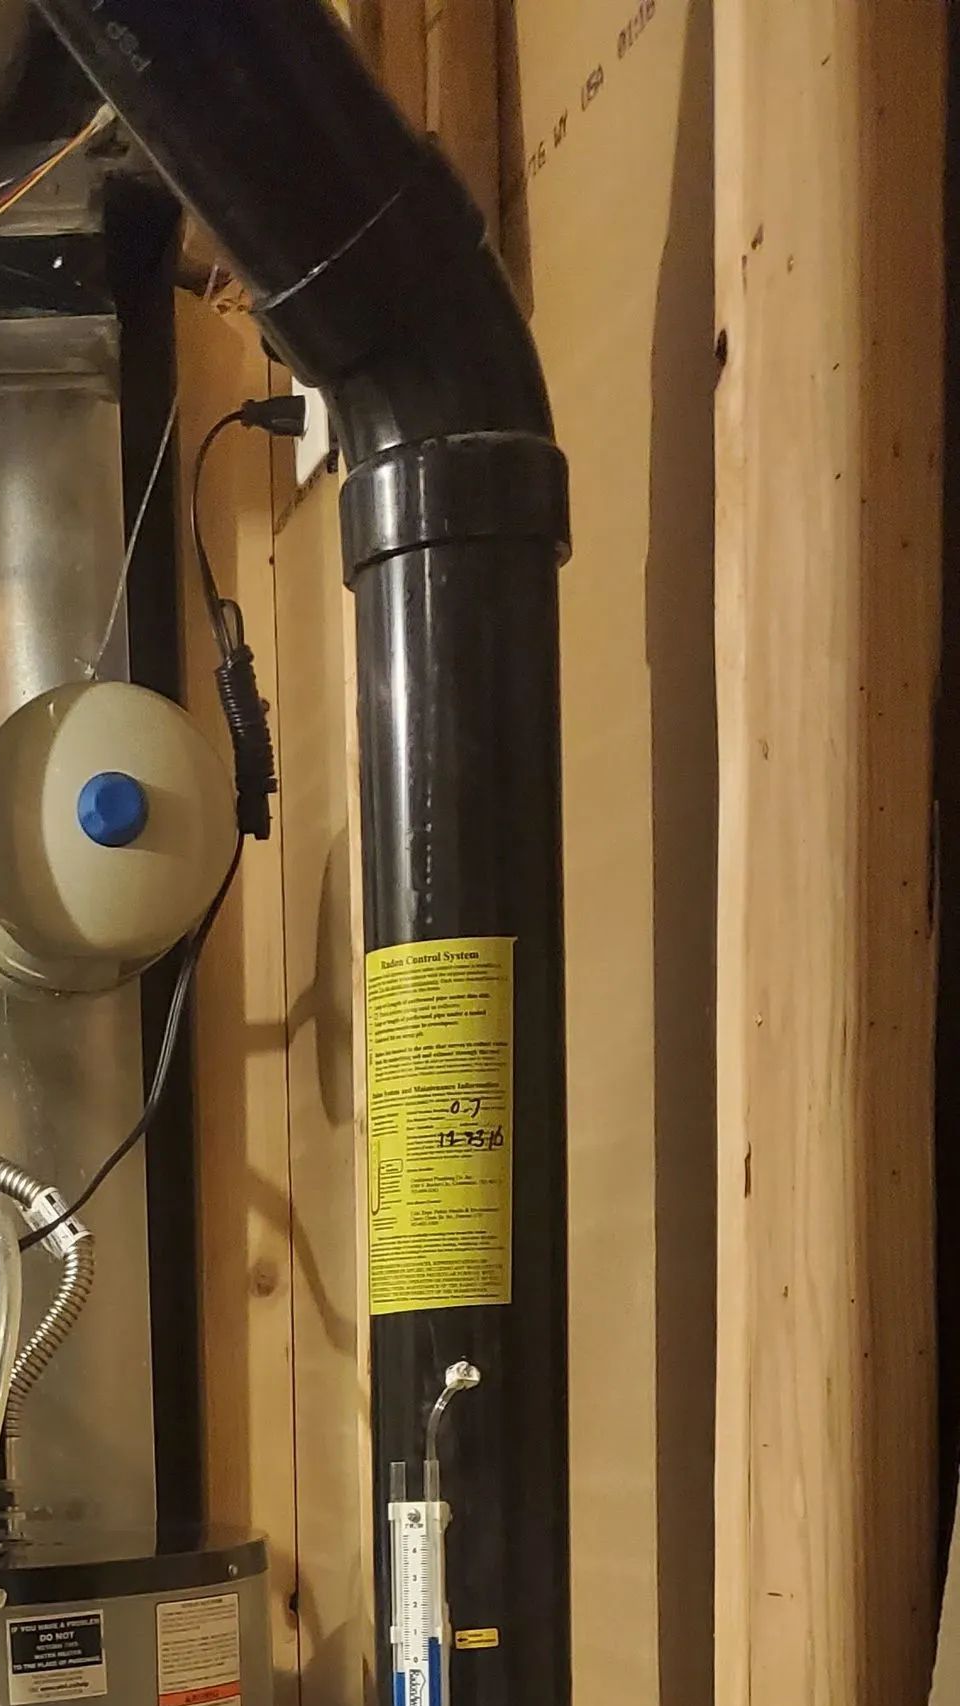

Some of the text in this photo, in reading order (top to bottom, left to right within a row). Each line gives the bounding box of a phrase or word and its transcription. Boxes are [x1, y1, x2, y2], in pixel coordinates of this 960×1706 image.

[406, 953, 441, 966] Control
[443, 950, 480, 963] System
[39, 1631, 75, 1642] DO NOT
